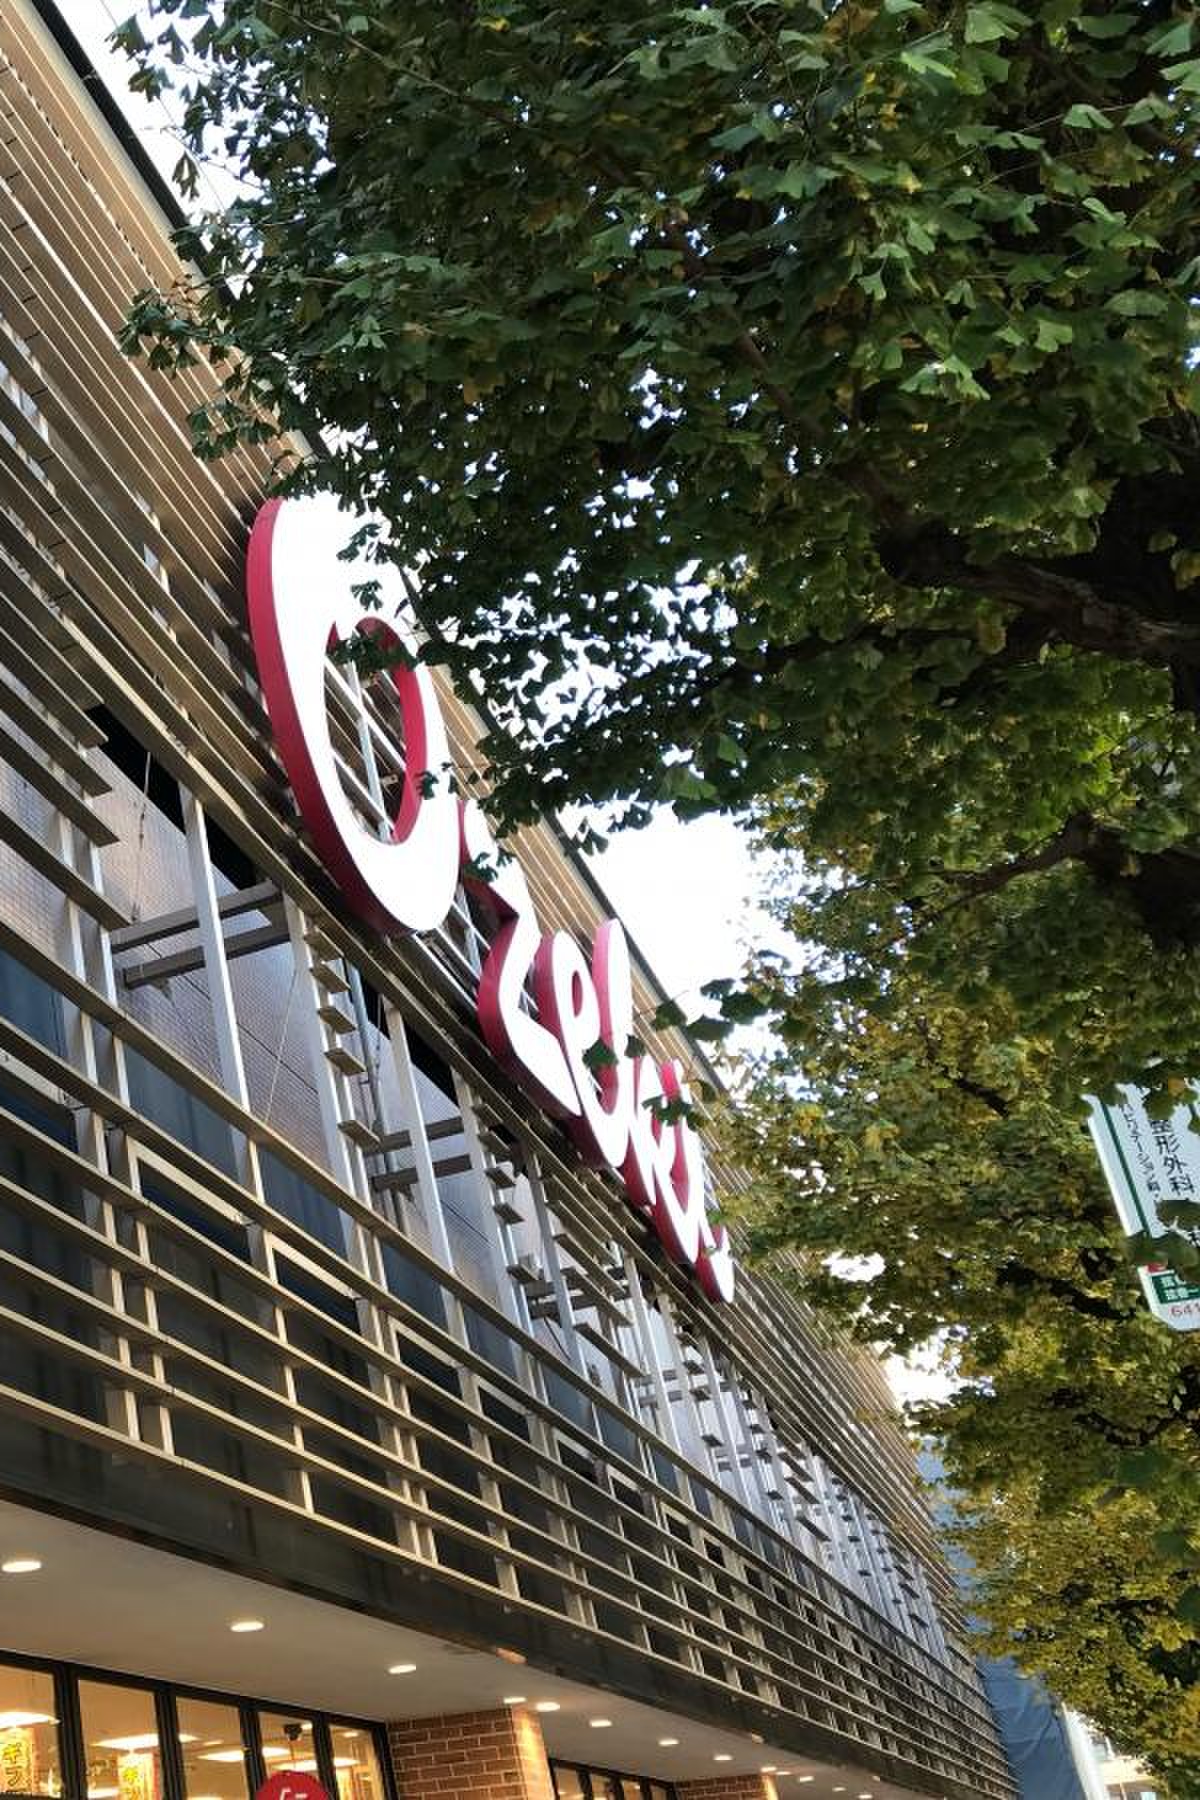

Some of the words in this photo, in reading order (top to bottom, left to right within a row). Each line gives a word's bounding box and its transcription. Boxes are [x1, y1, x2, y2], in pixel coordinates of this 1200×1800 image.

[246, 489, 734, 1304] Ozeki
[1150, 1119, 1195, 1196] 整形外科
